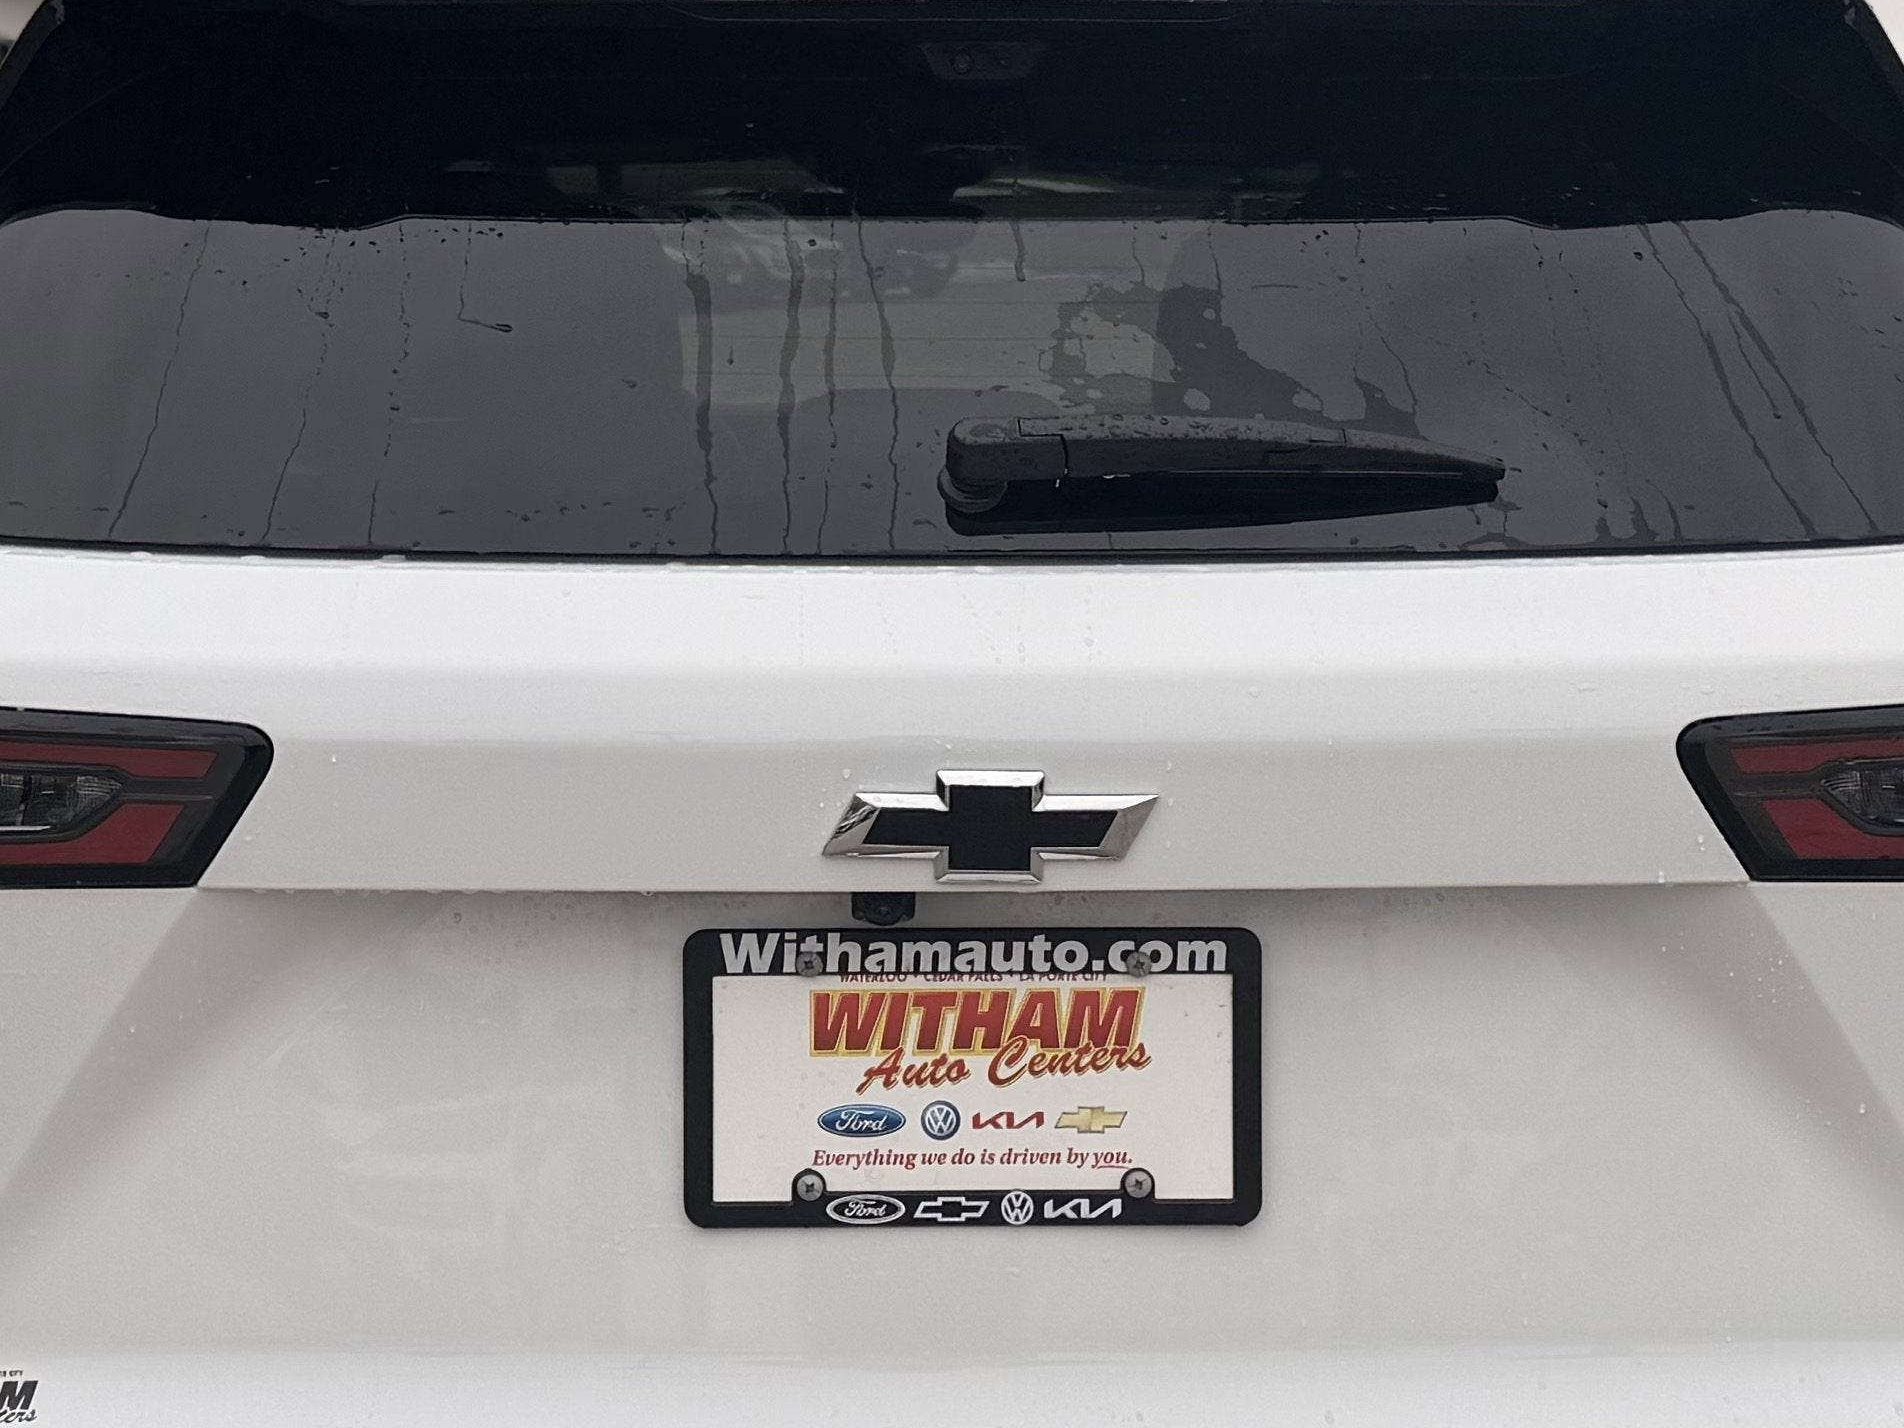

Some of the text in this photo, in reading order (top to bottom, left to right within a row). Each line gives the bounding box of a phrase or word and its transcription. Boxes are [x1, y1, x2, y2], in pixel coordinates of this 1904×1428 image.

[719, 932, 1228, 974] Withamauto.com
[810, 988, 1144, 1056] WITHAM
[855, 1035, 1151, 1095] Auto Centers
[812, 1148, 1133, 1170] Everything we do is driven by you.
